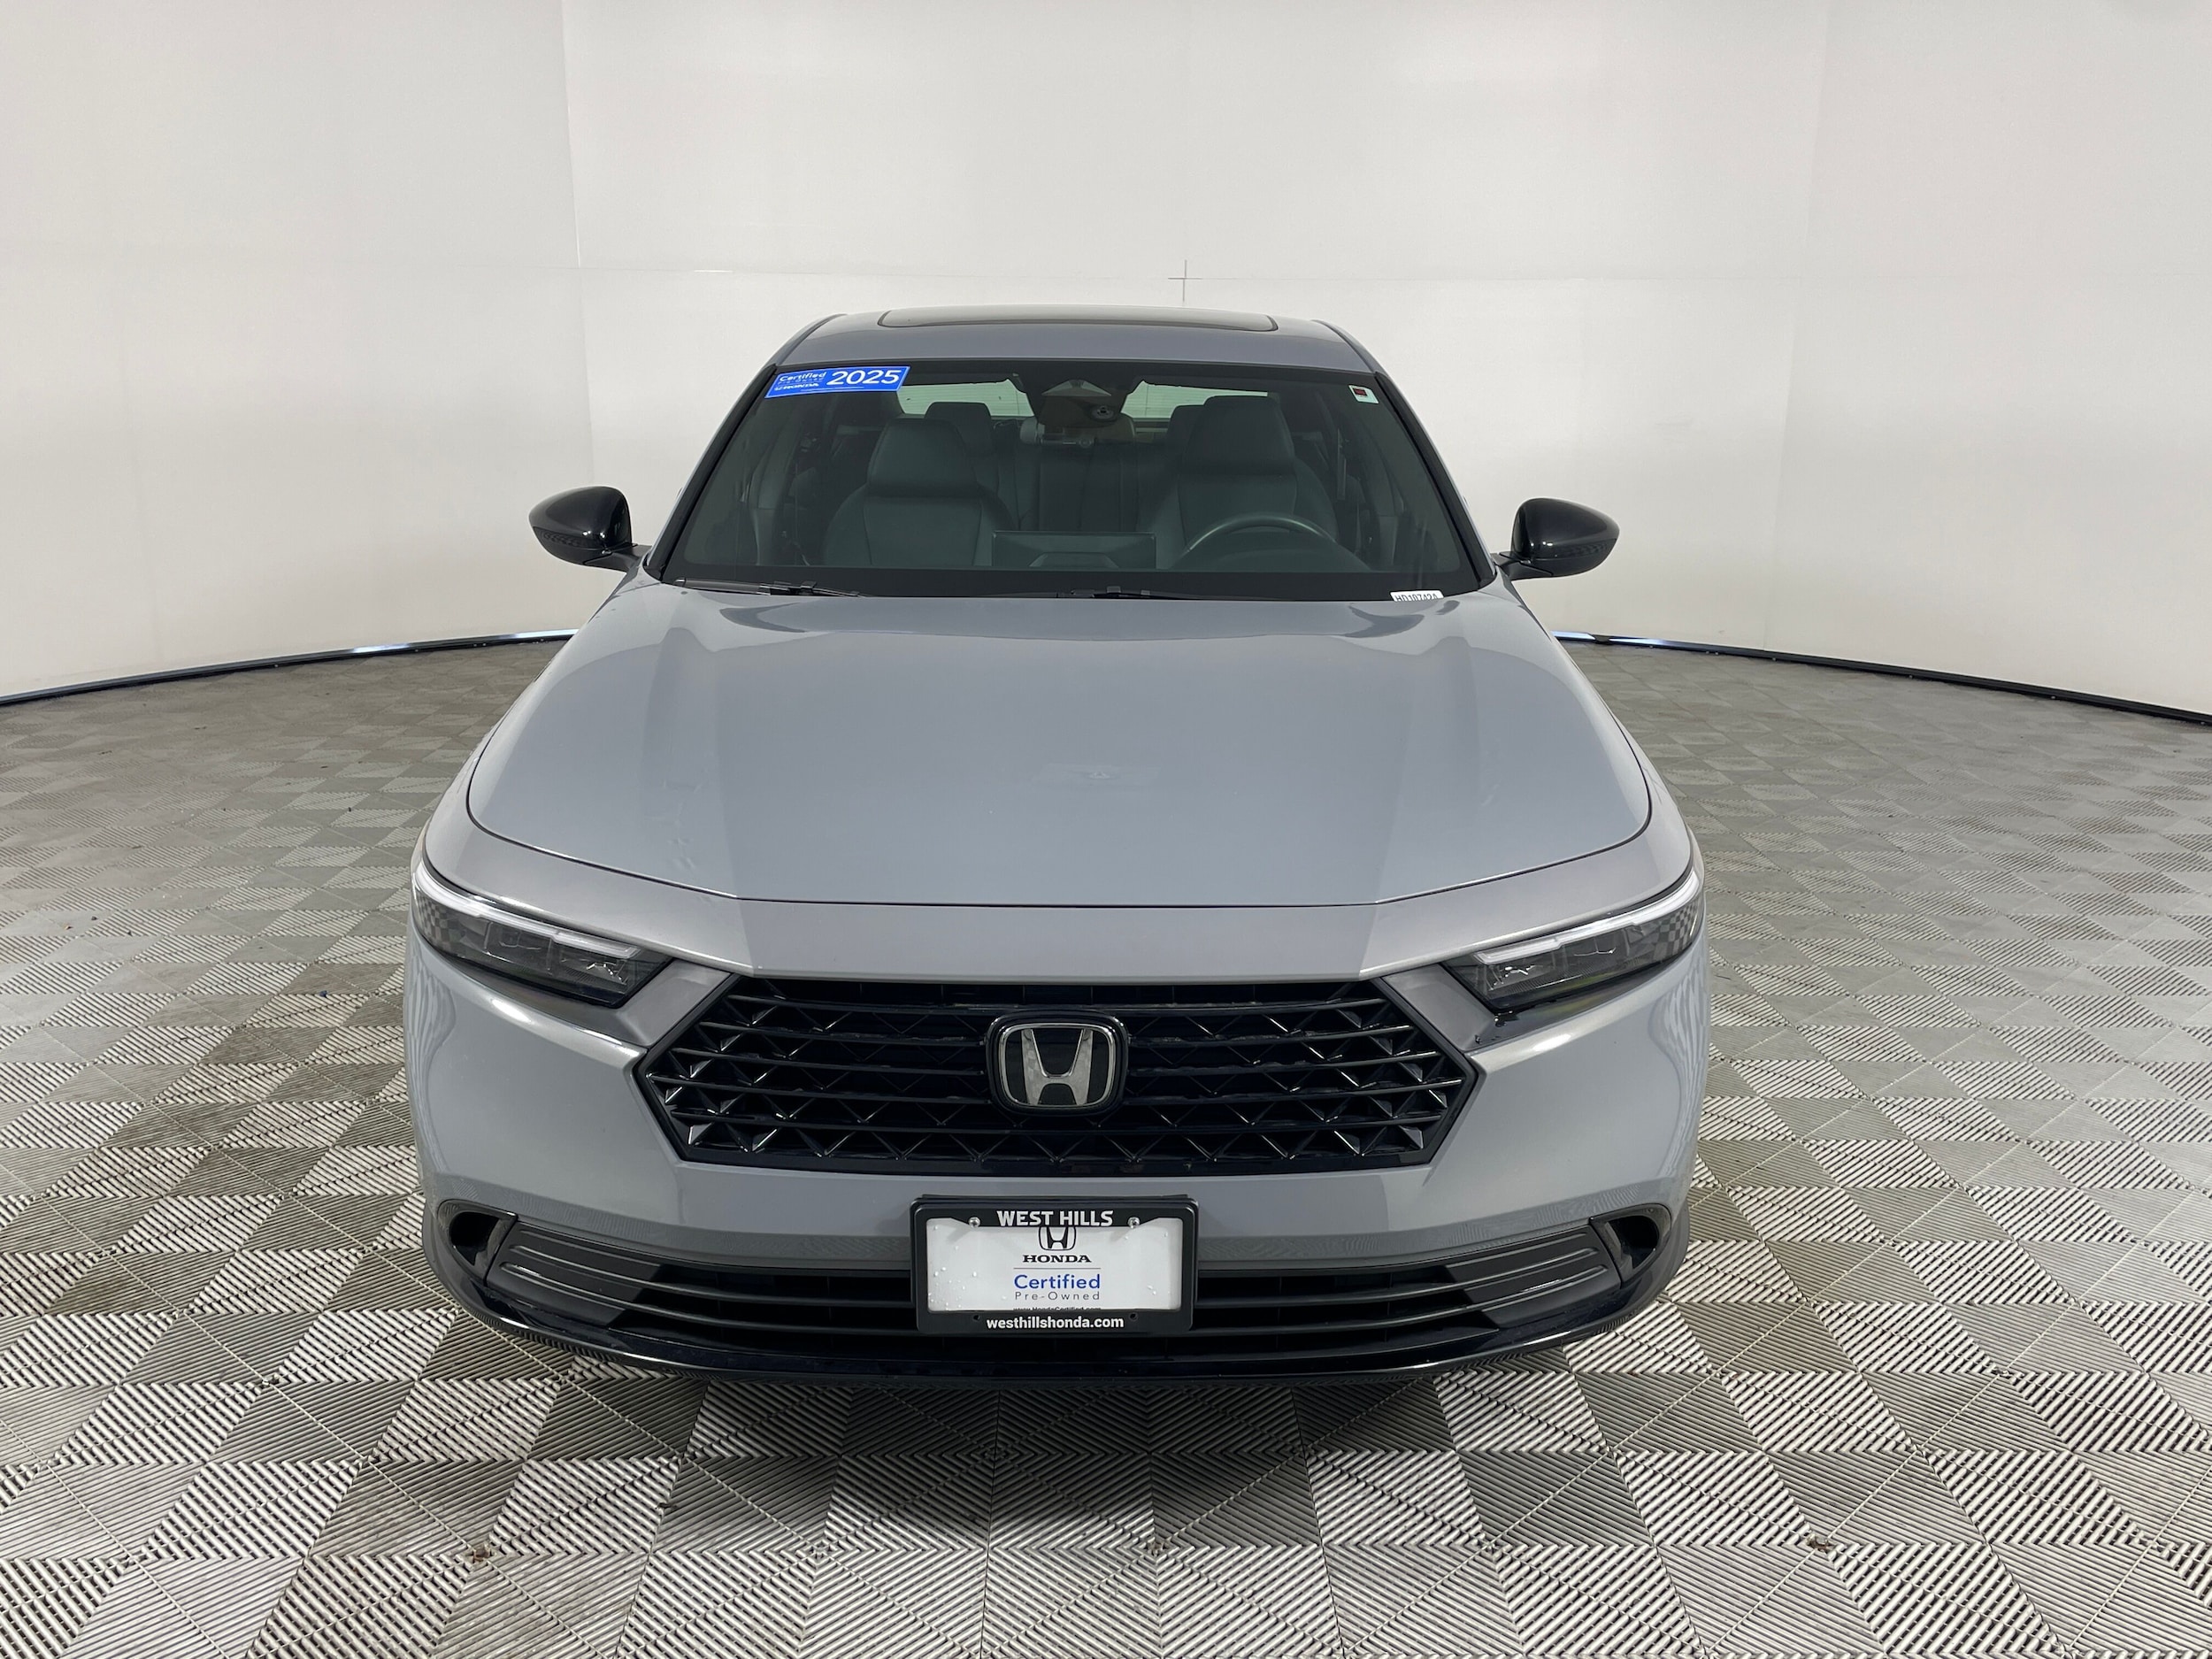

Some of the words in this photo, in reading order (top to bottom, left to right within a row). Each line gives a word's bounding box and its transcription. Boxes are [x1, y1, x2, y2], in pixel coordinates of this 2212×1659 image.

[780, 372, 826, 381] Certified
[826, 370, 902, 386] 2025
[996, 1210, 1054, 1226] WEST
[1059, 1210, 1114, 1226] HILLS
[1014, 1274, 1100, 1288] Certified
[1014, 1291, 1100, 1301] Pre-Owned
[987, 1316, 1125, 1329] westhillshonda.com
